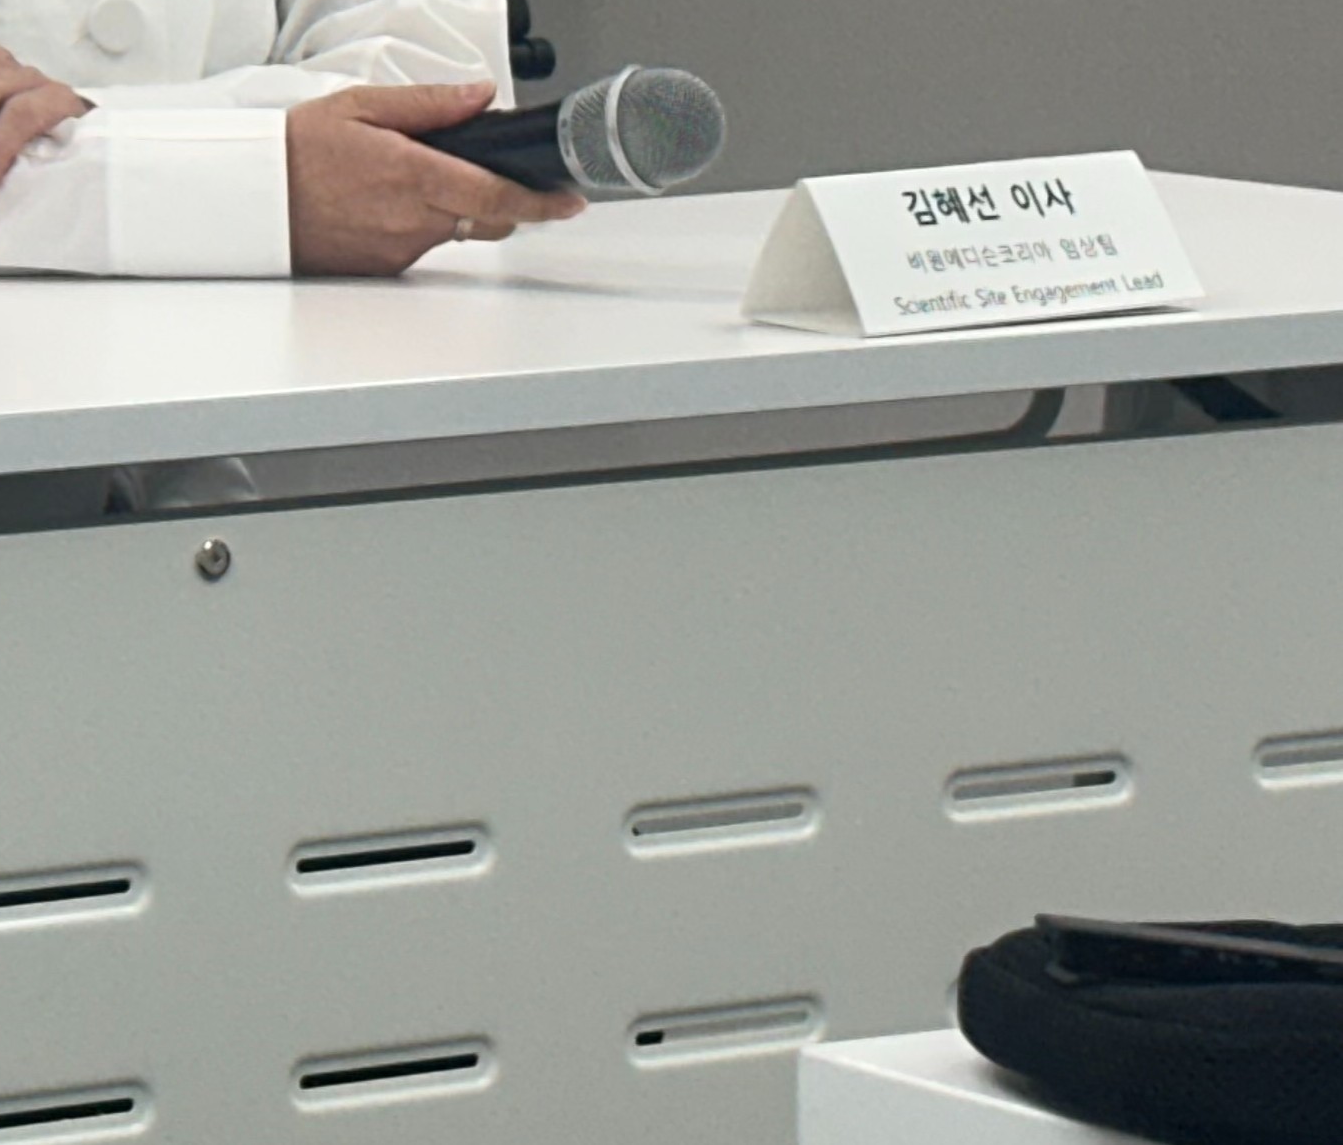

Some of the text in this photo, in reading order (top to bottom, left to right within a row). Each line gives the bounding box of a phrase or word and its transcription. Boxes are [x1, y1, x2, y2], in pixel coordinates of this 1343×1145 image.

[902, 178, 1077, 226] 김혜선 이사
[906, 233, 1119, 273] 비원메디슨코리아 임상팀
[893, 269, 1164, 316] Scientific Site Engagement Lead
